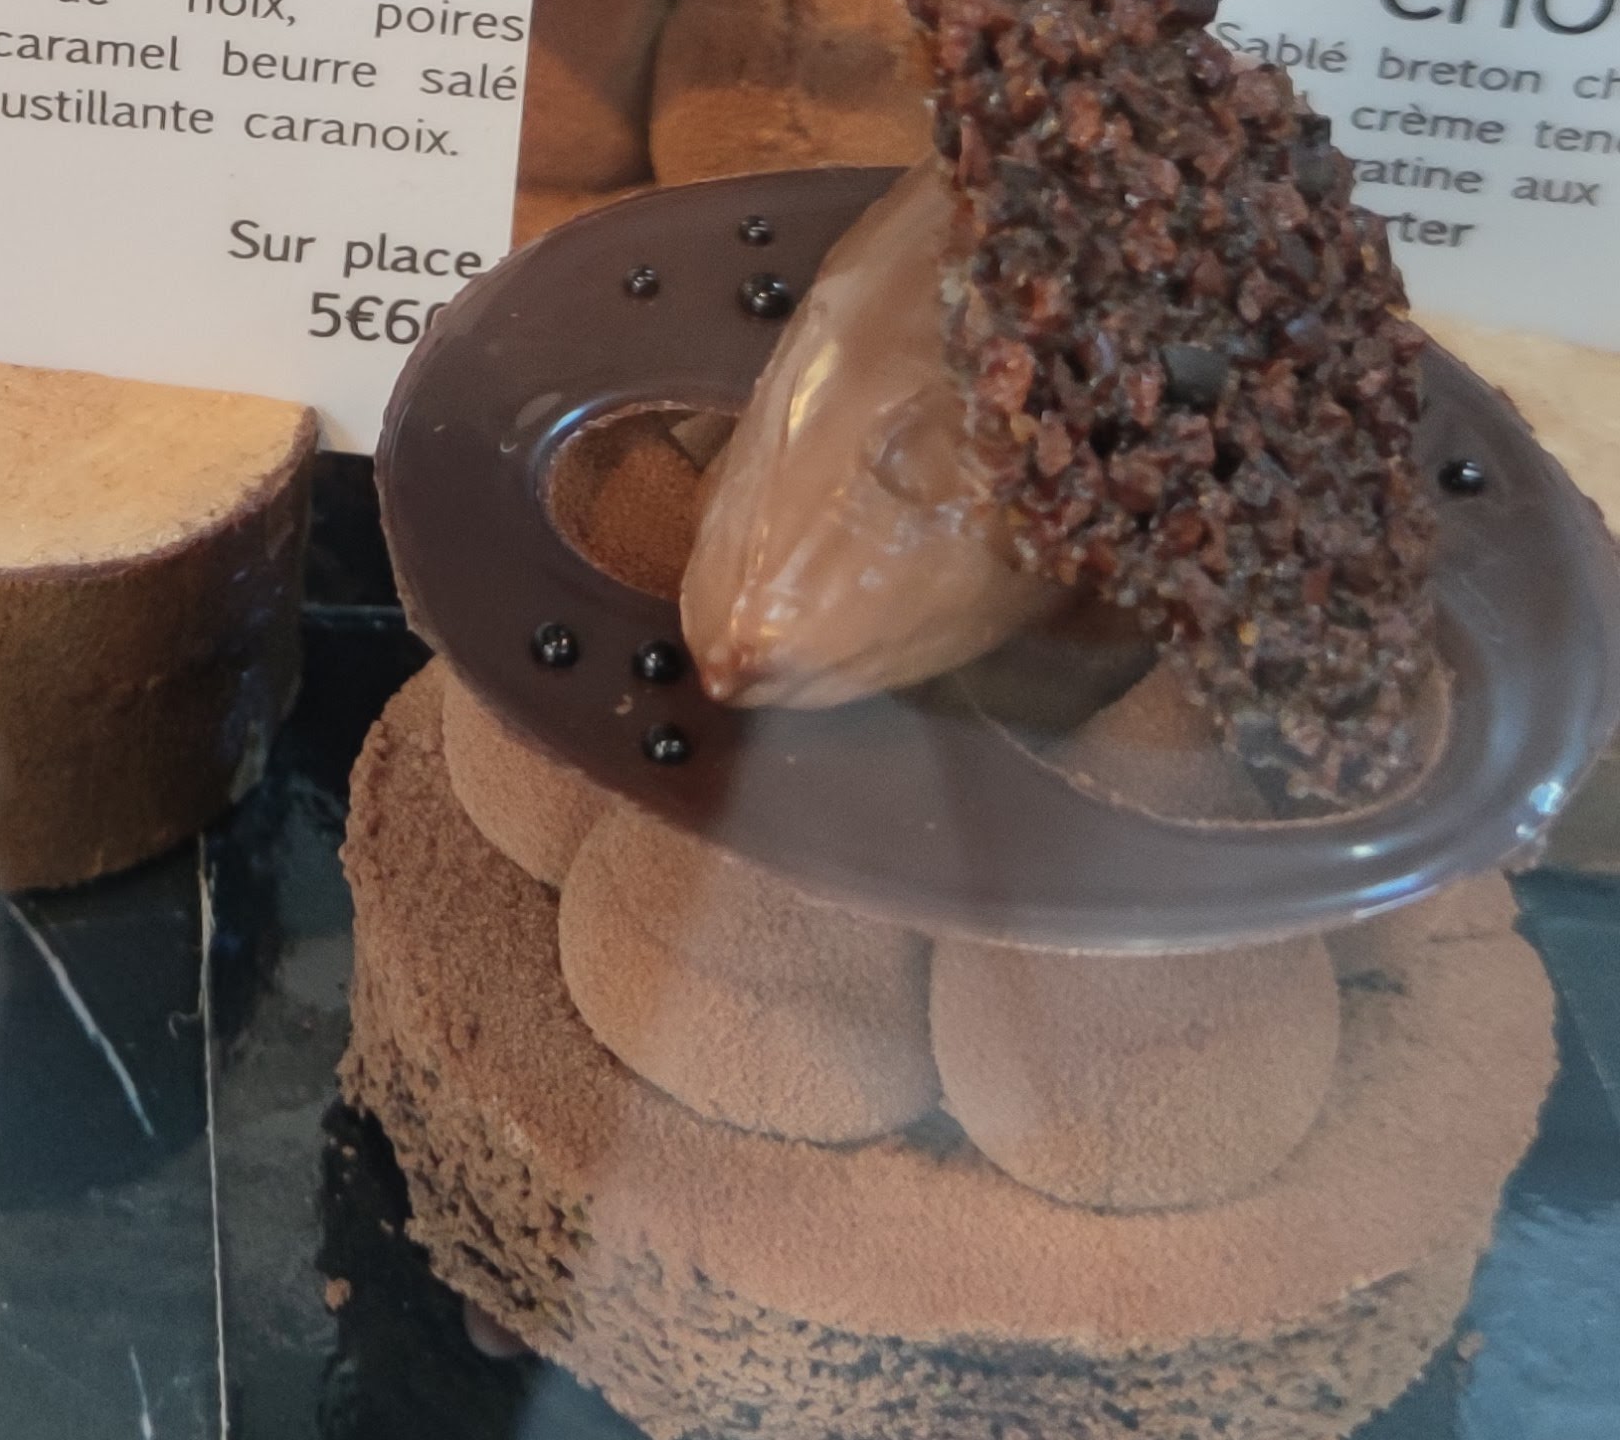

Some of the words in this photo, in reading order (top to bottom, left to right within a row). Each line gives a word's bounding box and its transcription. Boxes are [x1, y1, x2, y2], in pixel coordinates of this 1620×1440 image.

[375, 0, 524, 42] poires
[222, 39, 377, 88] beurre
[420, 63, 517, 102] salé
[1215, 22, 1348, 74] Sablé
[1378, 46, 1543, 94] breton
[244, 113, 458, 157] caranoix.
[1351, 104, 1505, 145] crème
[1353, 156, 1484, 195] atine
[1511, 173, 1601, 207] aux
[228, 219, 317, 264] Sur
[343, 232, 482, 279] place
